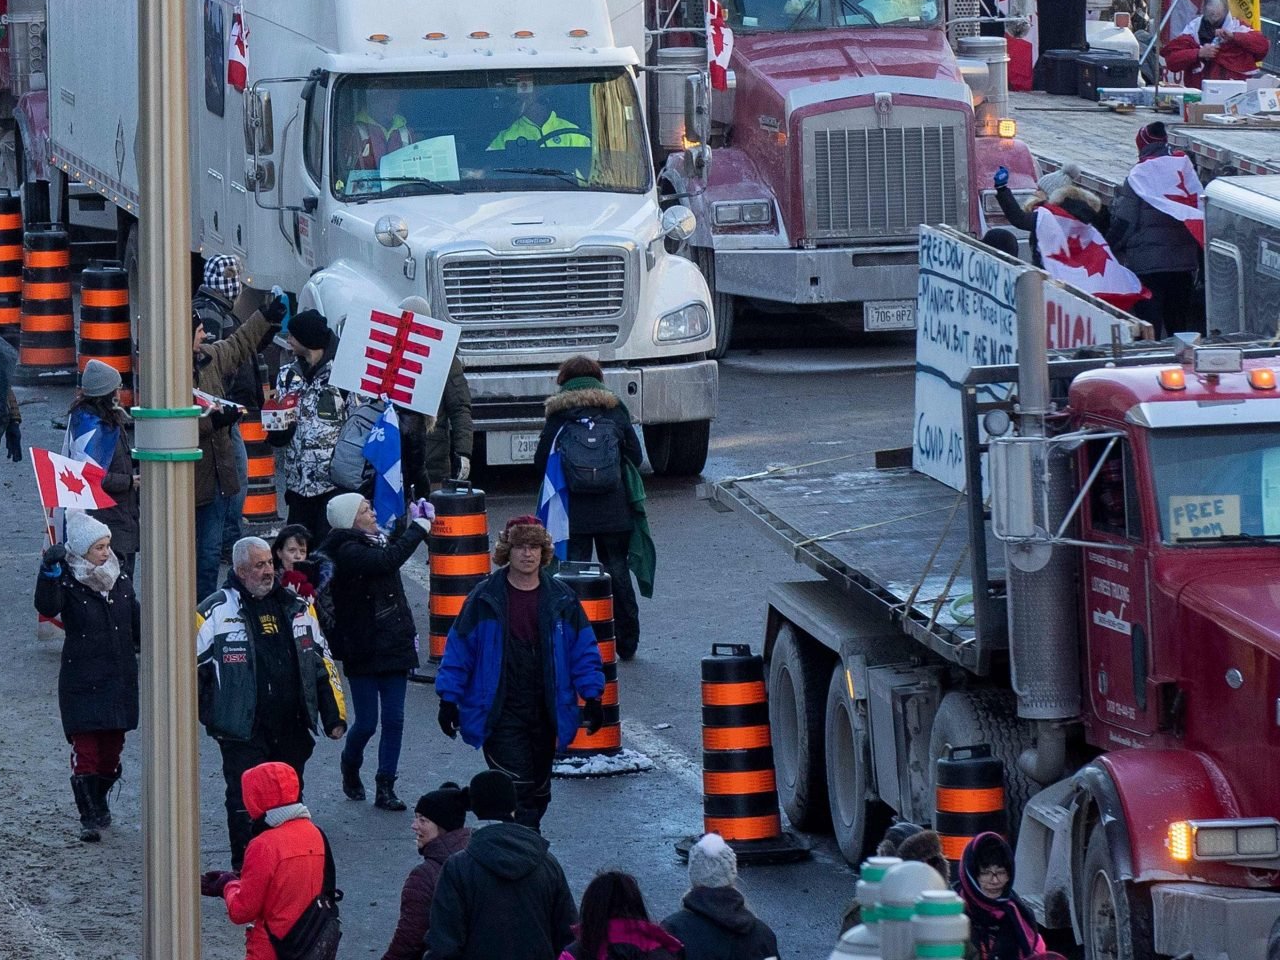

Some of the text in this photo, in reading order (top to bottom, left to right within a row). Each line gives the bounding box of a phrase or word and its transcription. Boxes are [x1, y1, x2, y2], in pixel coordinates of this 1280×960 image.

[921, 233, 964, 281] FREEDOM
[968, 251, 1000, 297] CONVOY
[875, 310, 891, 323] 706
[972, 335, 988, 366] ARE
[990, 338, 1013, 366] NOT
[918, 412, 944, 463] COVID
[1173, 499, 1225, 526] FREE
[1190, 522, 1225, 537] DOM
[223, 654, 247, 663] NSK
